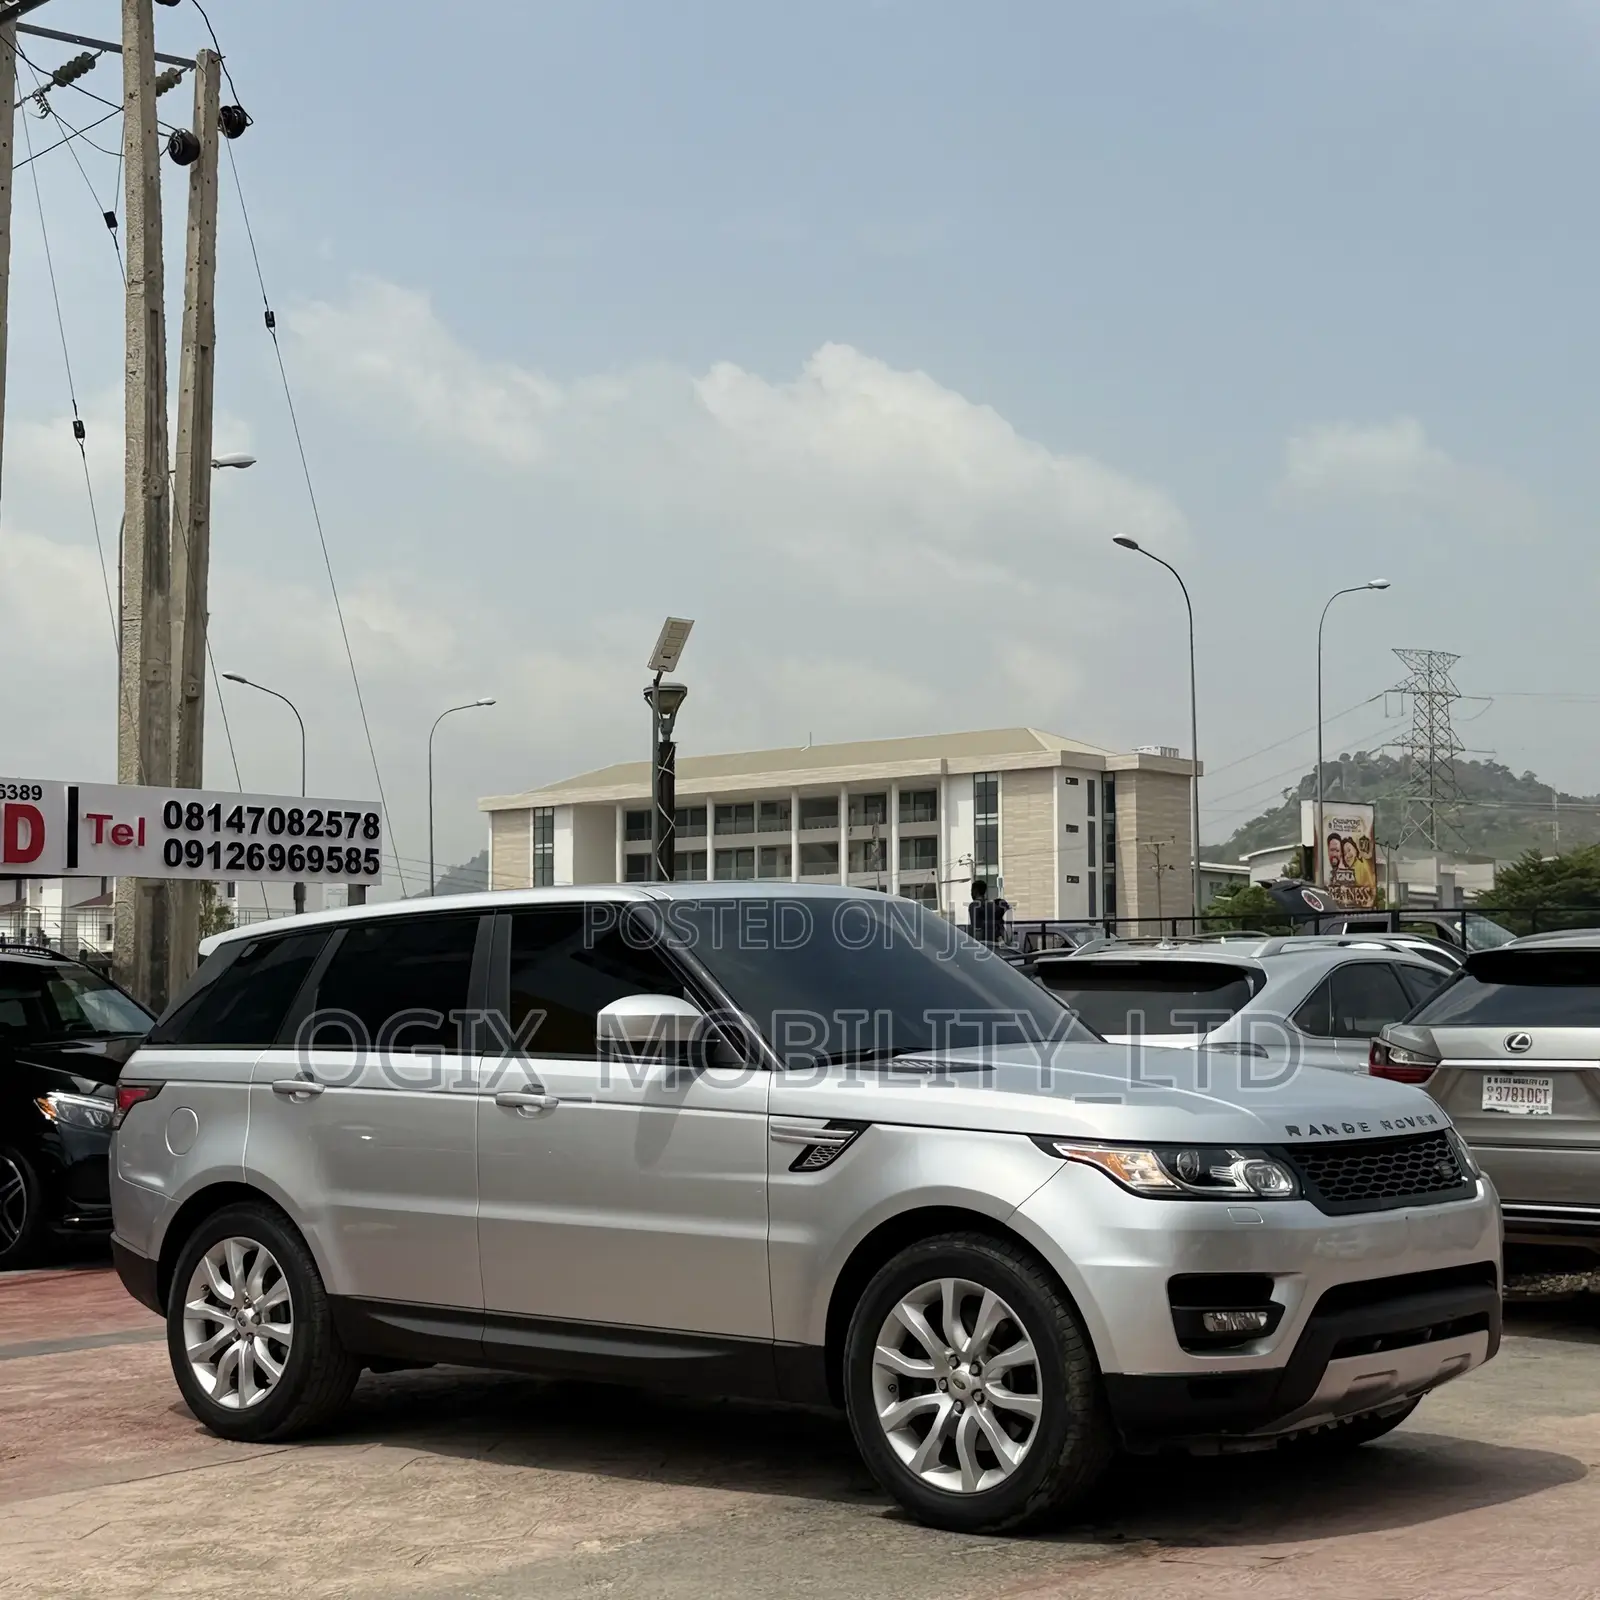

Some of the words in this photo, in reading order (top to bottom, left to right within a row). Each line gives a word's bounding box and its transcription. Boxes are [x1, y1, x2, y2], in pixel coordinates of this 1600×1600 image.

[86, 813, 146, 848] Tel
[163, 800, 380, 840] 08147082578
[163, 838, 380, 875] 09126969585
[1285, 1122, 1371, 1137] RANGE
